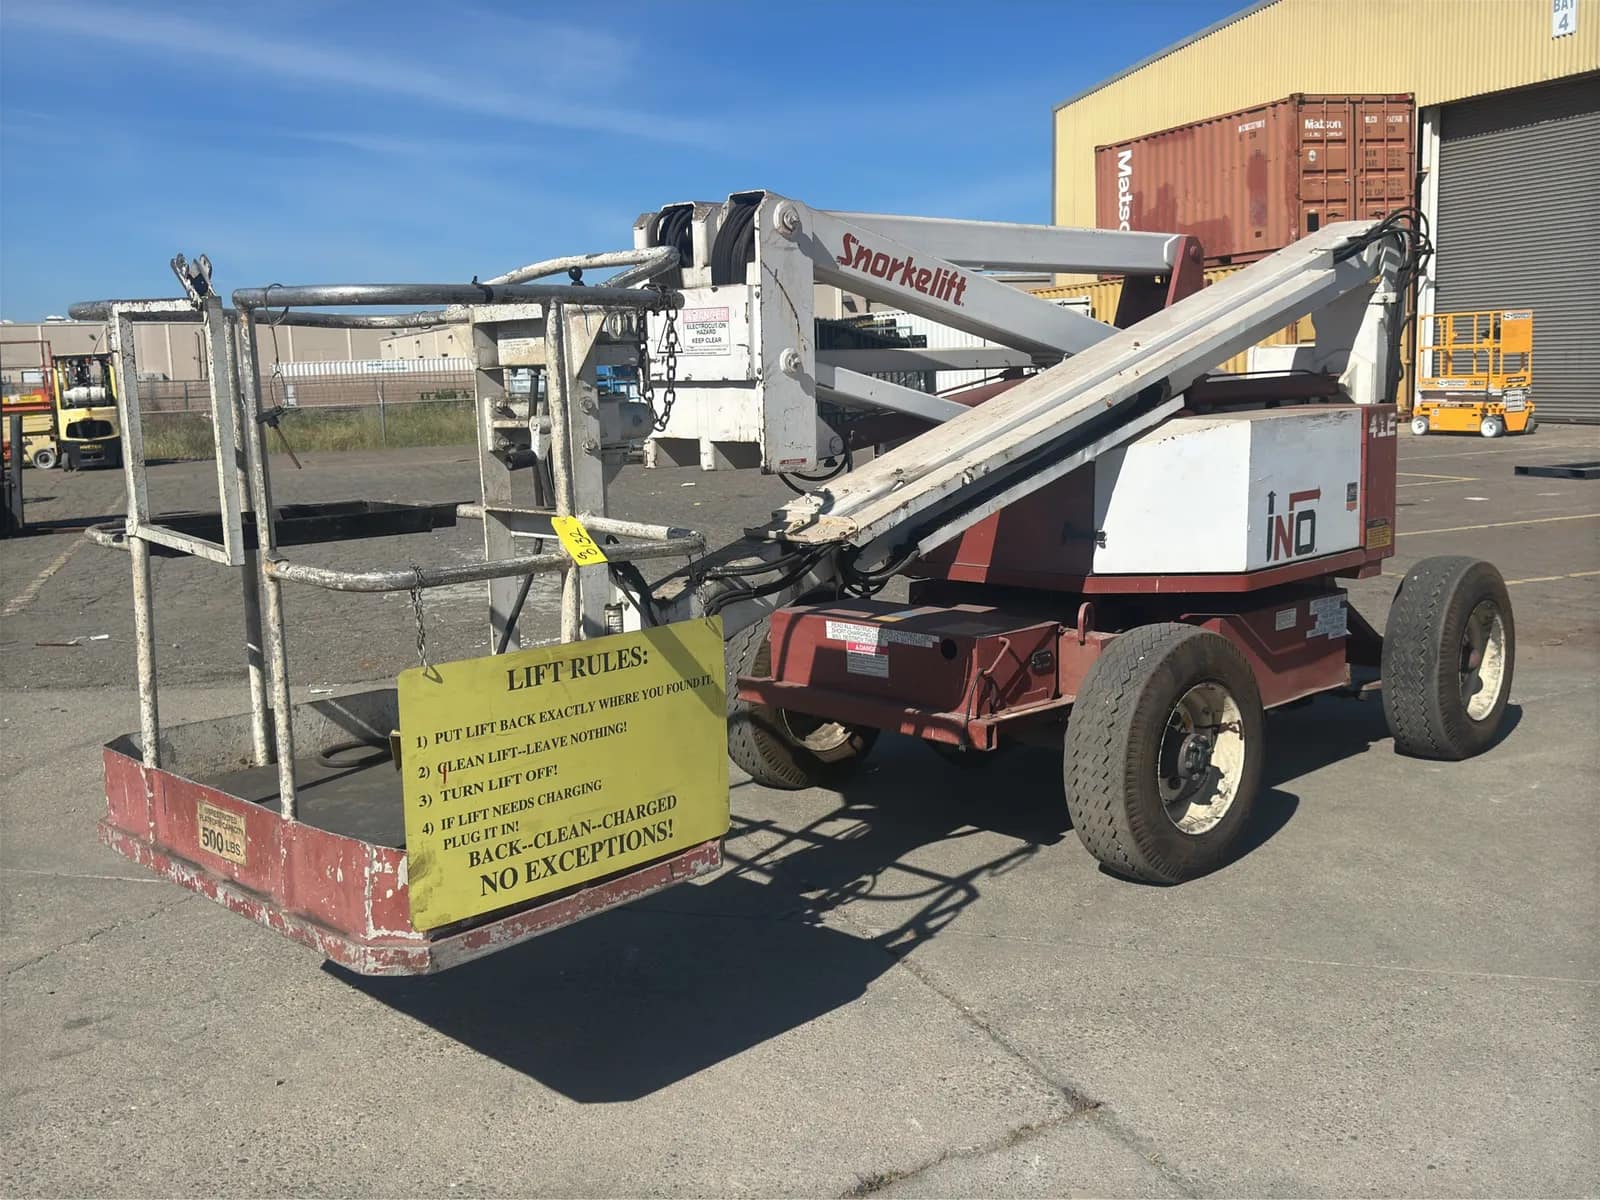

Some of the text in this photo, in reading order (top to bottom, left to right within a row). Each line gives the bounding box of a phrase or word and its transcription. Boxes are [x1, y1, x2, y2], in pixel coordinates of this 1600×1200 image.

[1558, 13, 1569, 30] 4
[836, 232, 967, 307] Snorkelift
[705, 336, 722, 344] CLEAR
[506, 646, 649, 691] LIFT RULES:
[416, 674, 714, 748] 1) PUT LIFT BACK EXACTLY WHERE YOU FOUND IT.
[418, 766, 430, 779] 2)
[437, 753, 485, 775] CLEAN
[570, 721, 628, 741] NOTHING!
[418, 764, 558, 808] 3) TURN LIFT OFF!
[422, 779, 603, 836] 4) IF LIFT NEEDS CHARGING
[202, 826, 243, 857] 500 LBS.
[443, 820, 520, 850] PLUG IT IN!
[480, 818, 674, 896] NO EXCEPTIONS!
